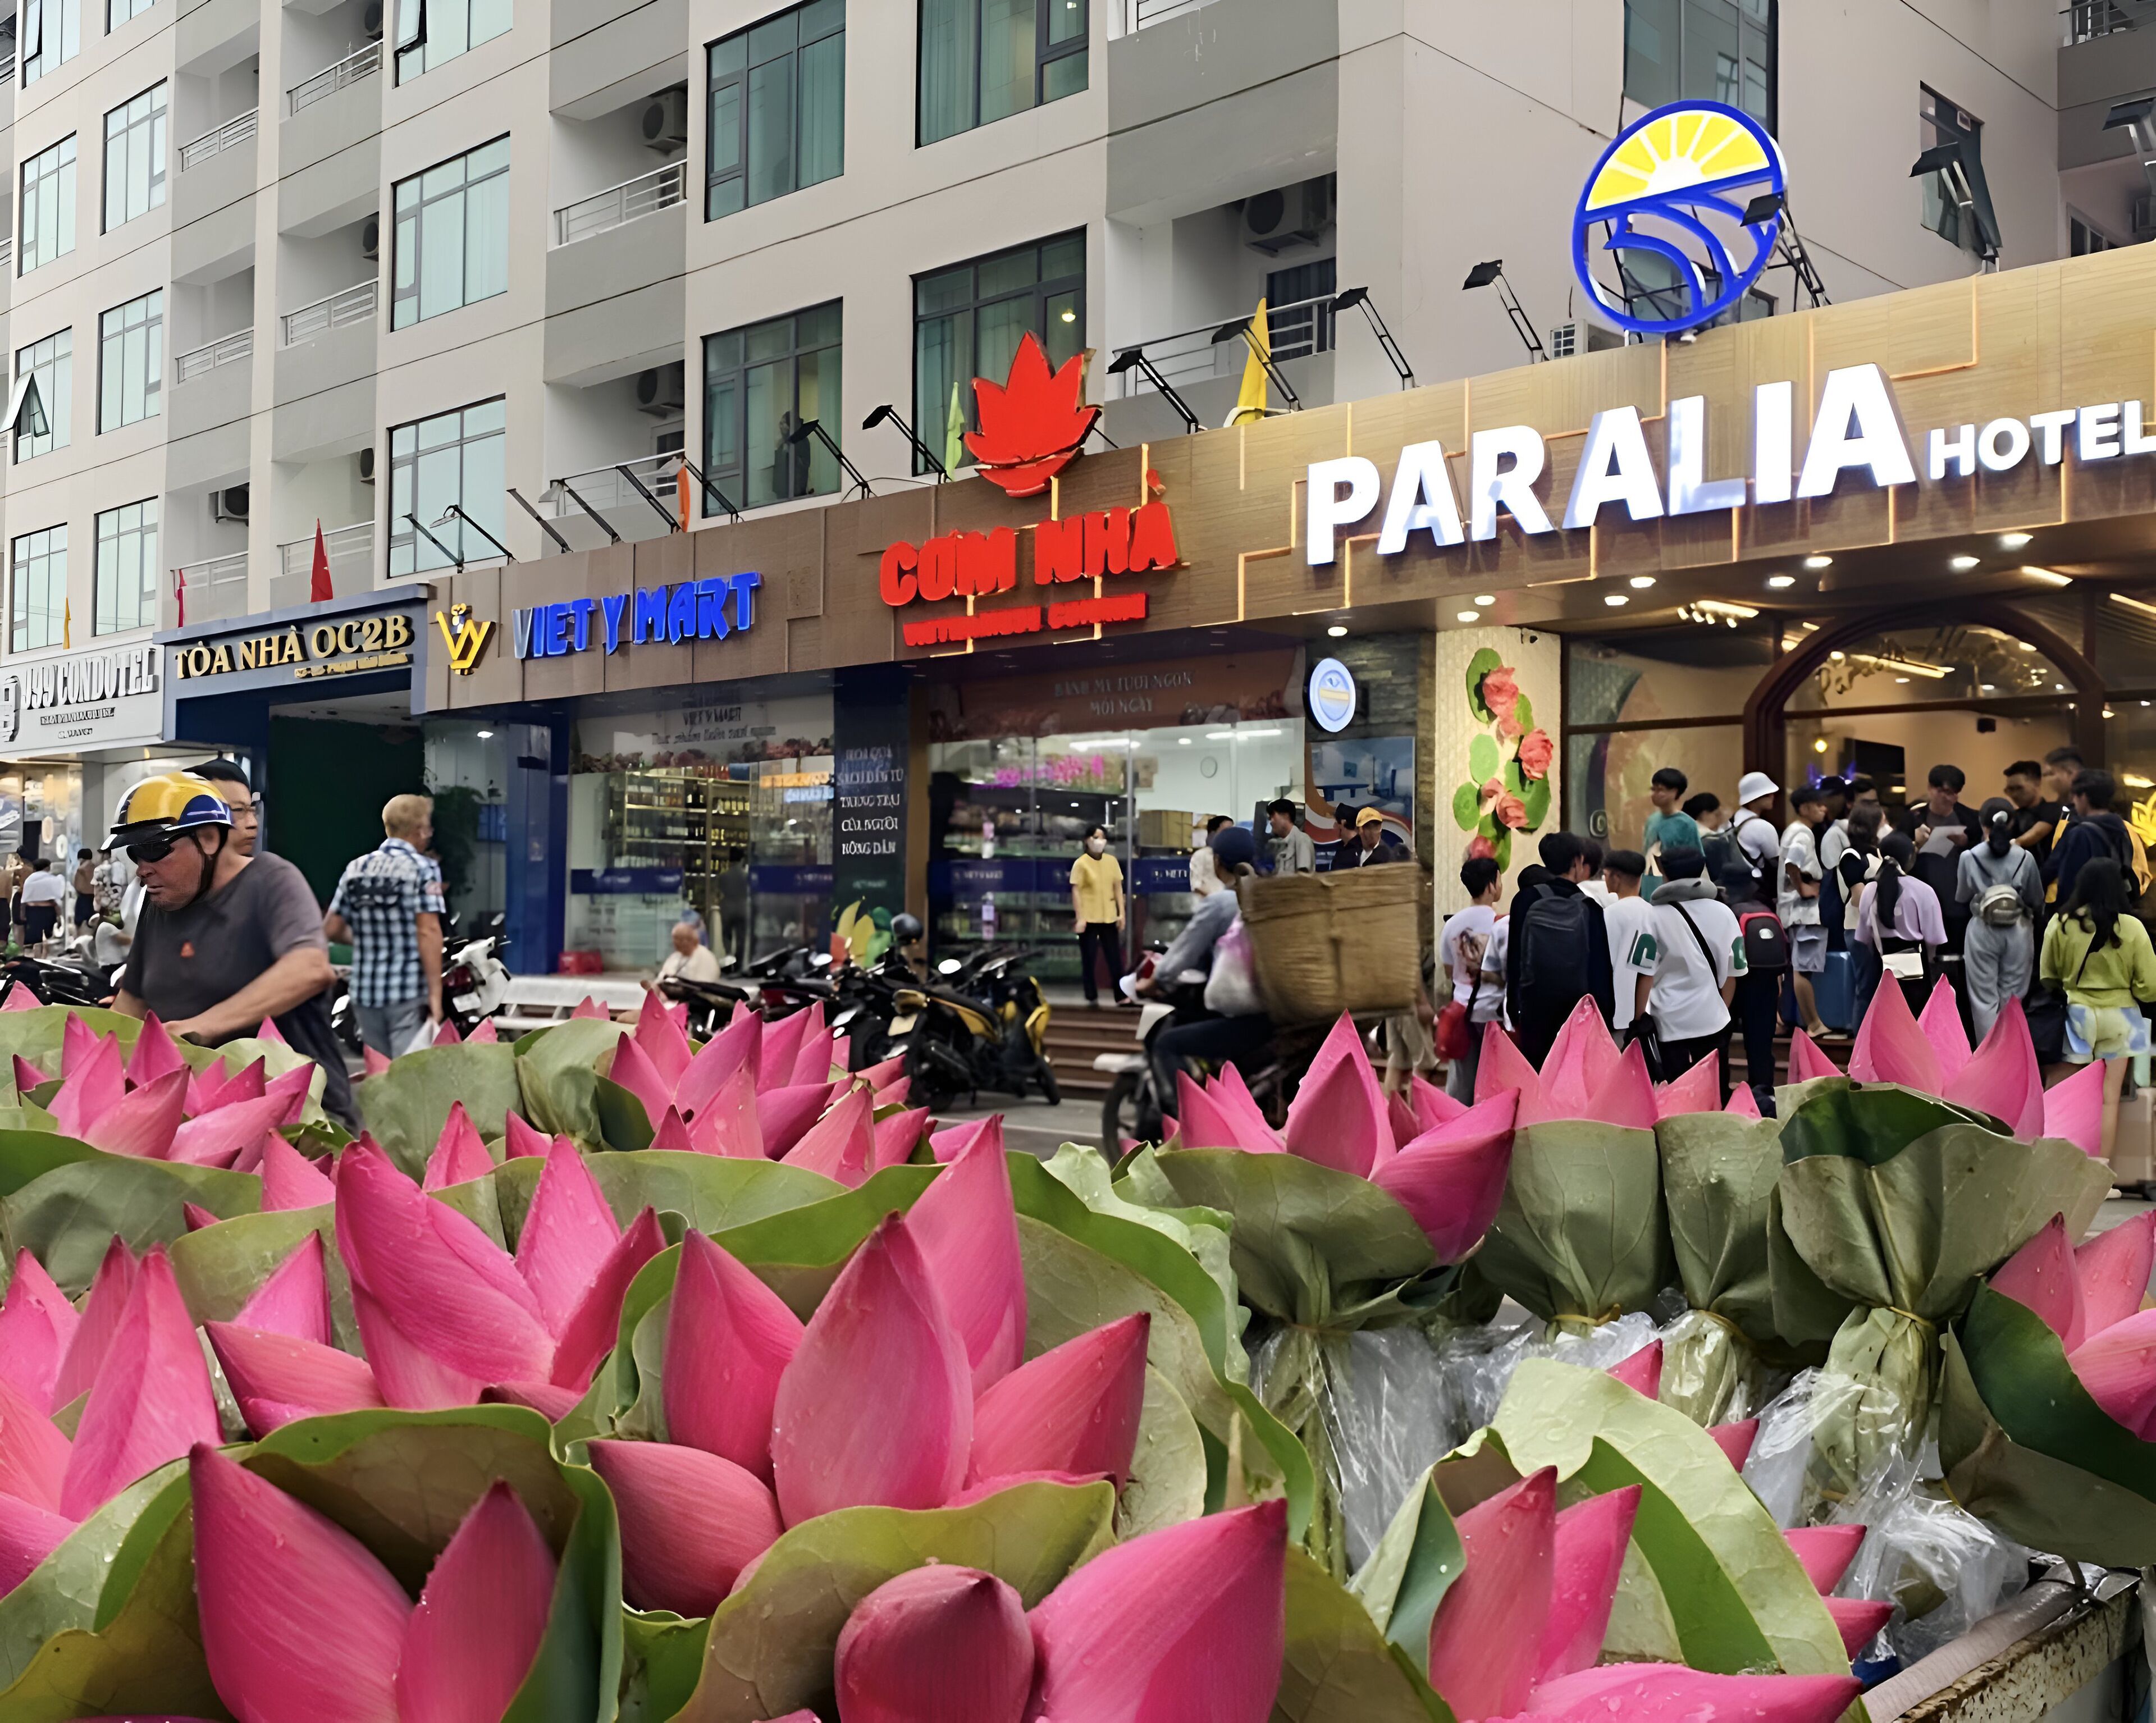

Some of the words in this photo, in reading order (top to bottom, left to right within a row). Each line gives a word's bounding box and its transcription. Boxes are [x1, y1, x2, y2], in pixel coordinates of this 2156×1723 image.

[1307, 363, 1916, 565] PARALIA
[1930, 400, 2156, 479] HOTEL
[175, 641, 233, 679] TÒA
[239, 625, 307, 670] NHÀ
[311, 615, 412, 659] OC2B
[512, 598, 596, 659] VIET
[601, 593, 630, 656] Y
[634, 572, 765, 645] MART
[57, 648, 158, 705] CONDOTEL
